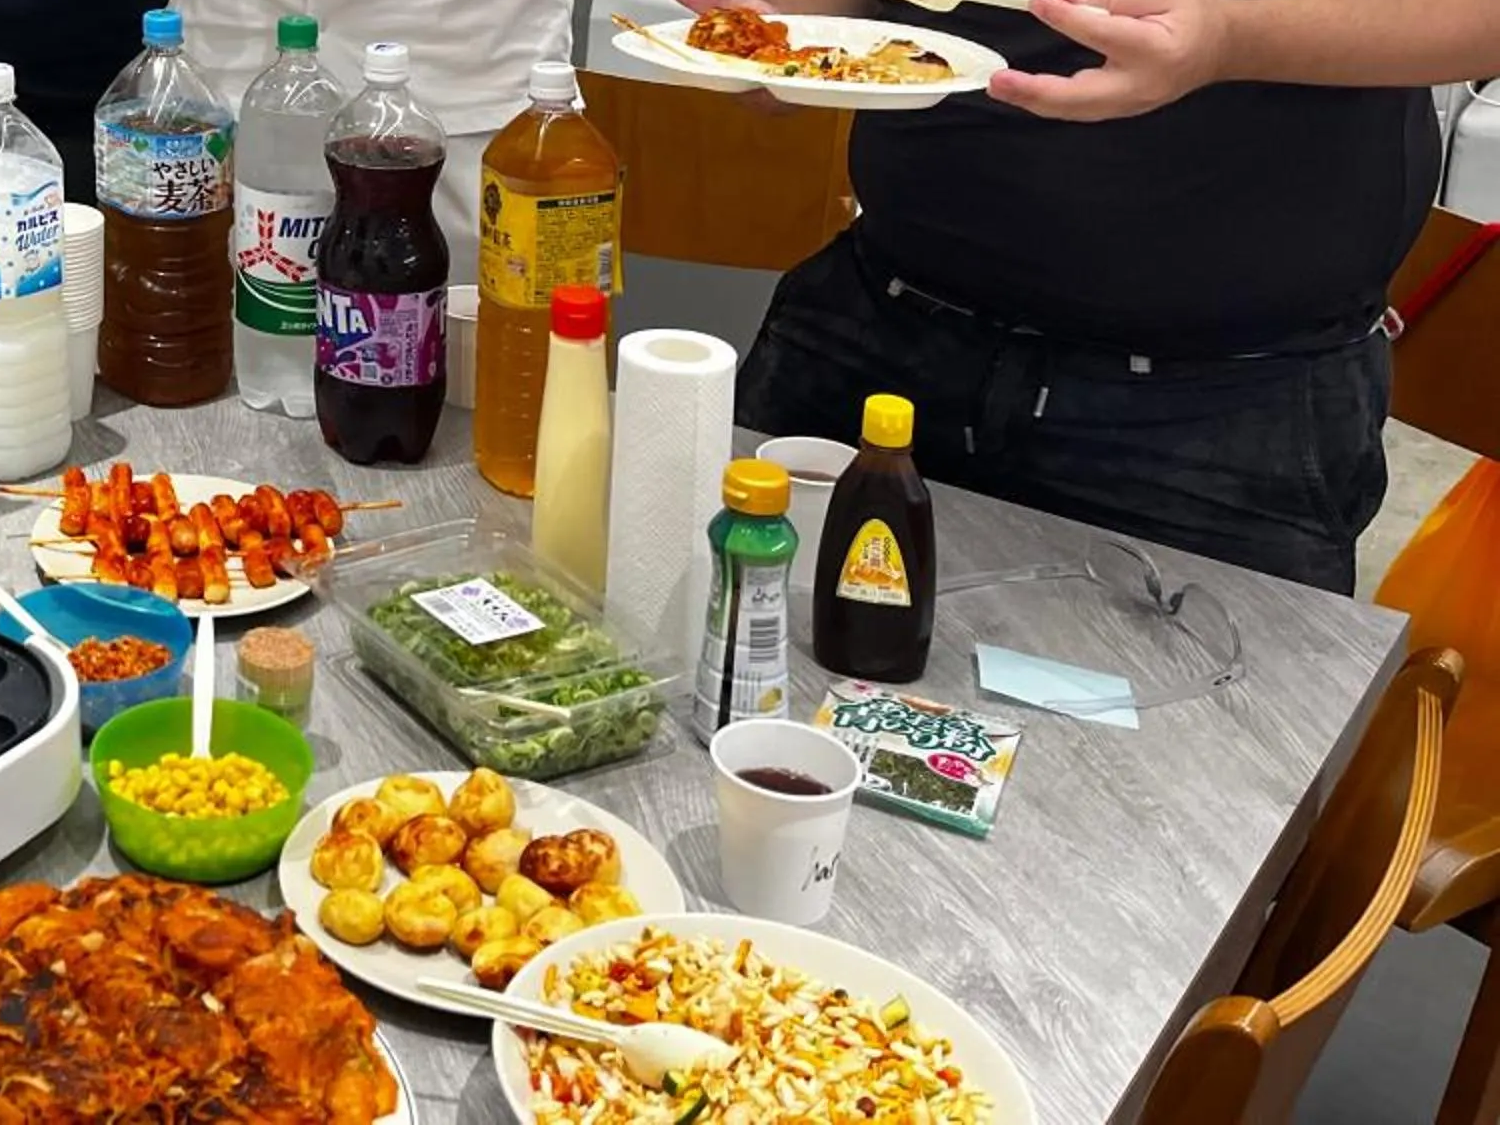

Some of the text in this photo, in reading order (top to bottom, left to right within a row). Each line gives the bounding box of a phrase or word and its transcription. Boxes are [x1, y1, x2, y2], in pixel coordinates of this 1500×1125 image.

[153, 158, 215, 180] やさしい
[155, 175, 214, 213] 麦茶
[16, 210, 60, 234] カルピス
[279, 216, 326, 238] MIT
[15, 224, 60, 252] Water
[317, 289, 369, 334] NTA
